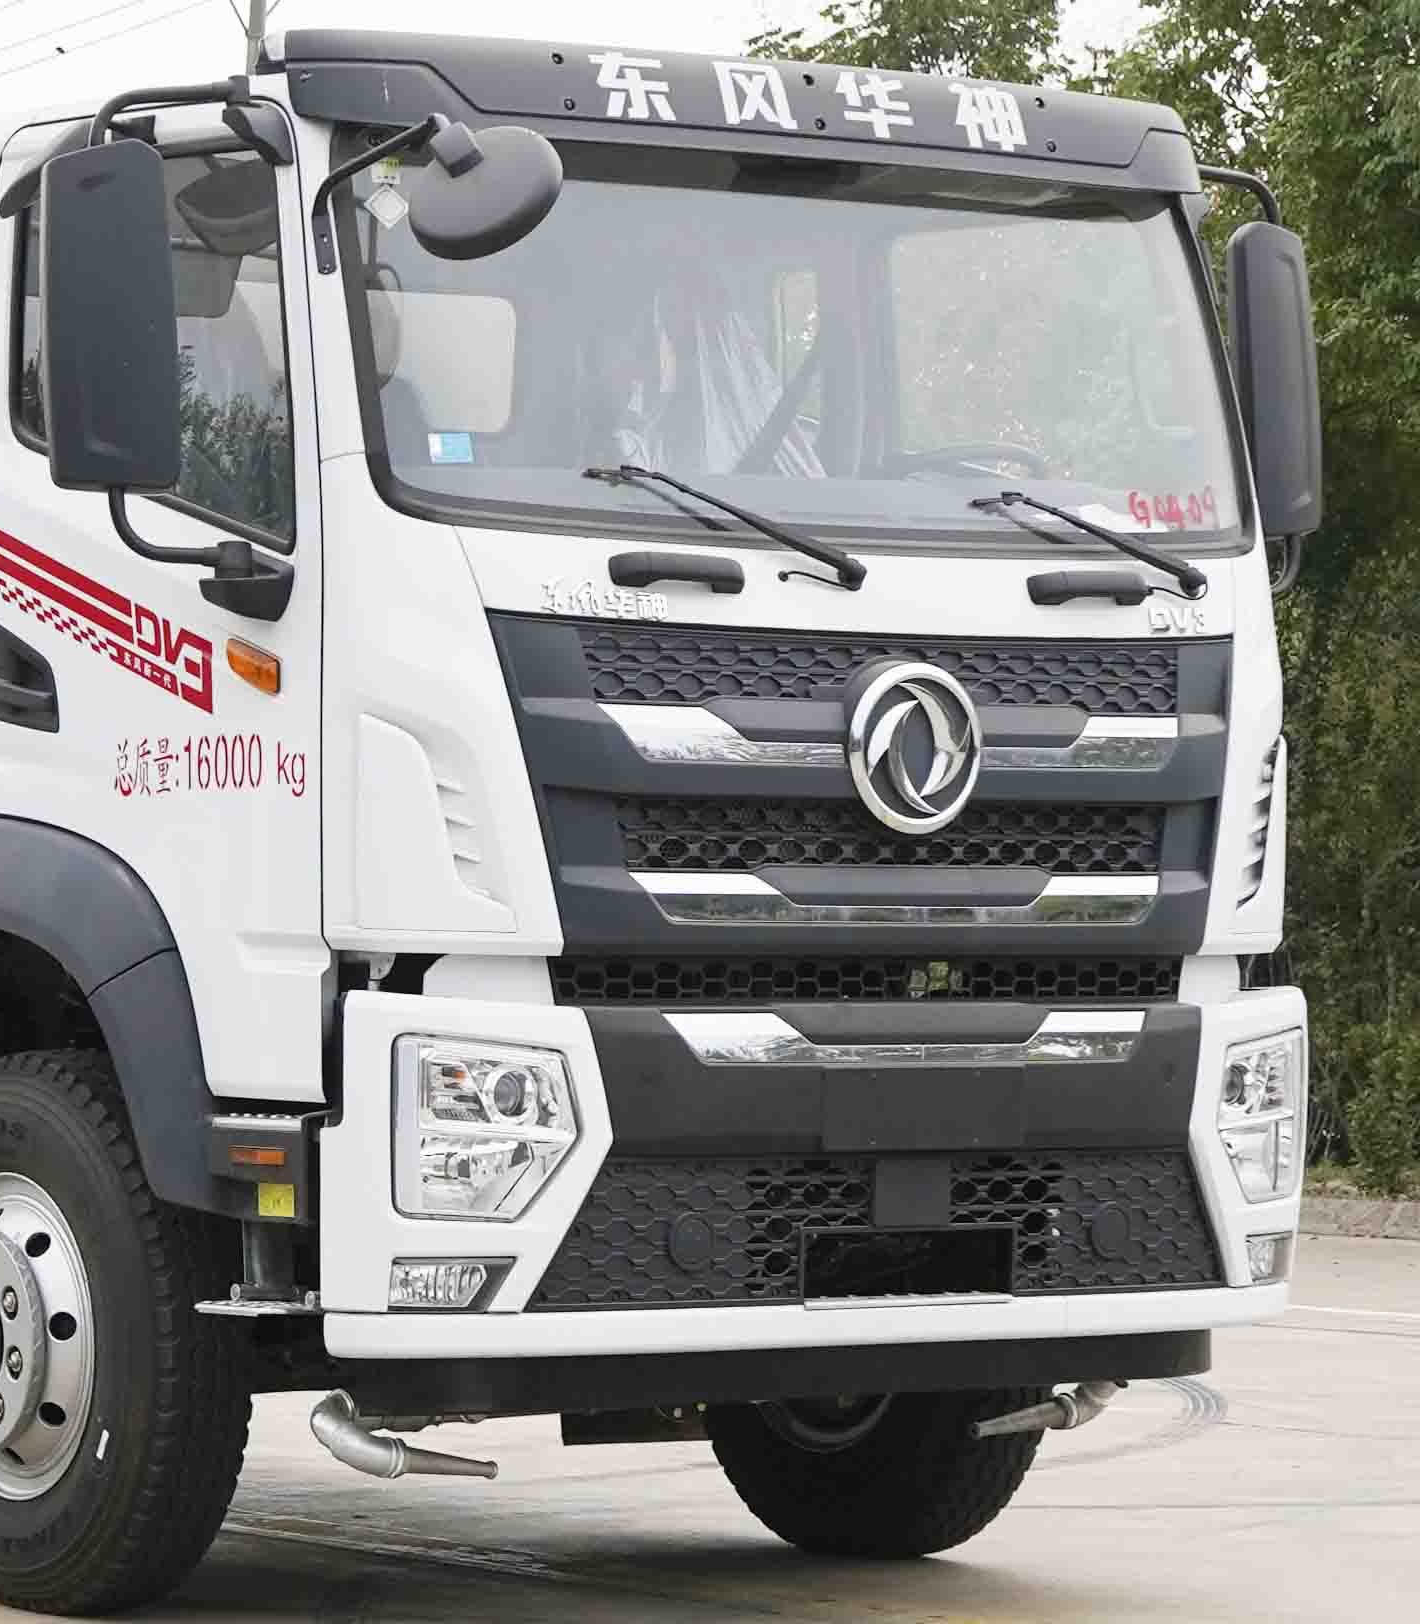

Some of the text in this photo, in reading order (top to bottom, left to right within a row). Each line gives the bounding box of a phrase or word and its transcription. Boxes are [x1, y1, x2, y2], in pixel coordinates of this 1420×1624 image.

[588, 52, 1028, 152] 东风华神
[276, 741, 305, 797] kg
